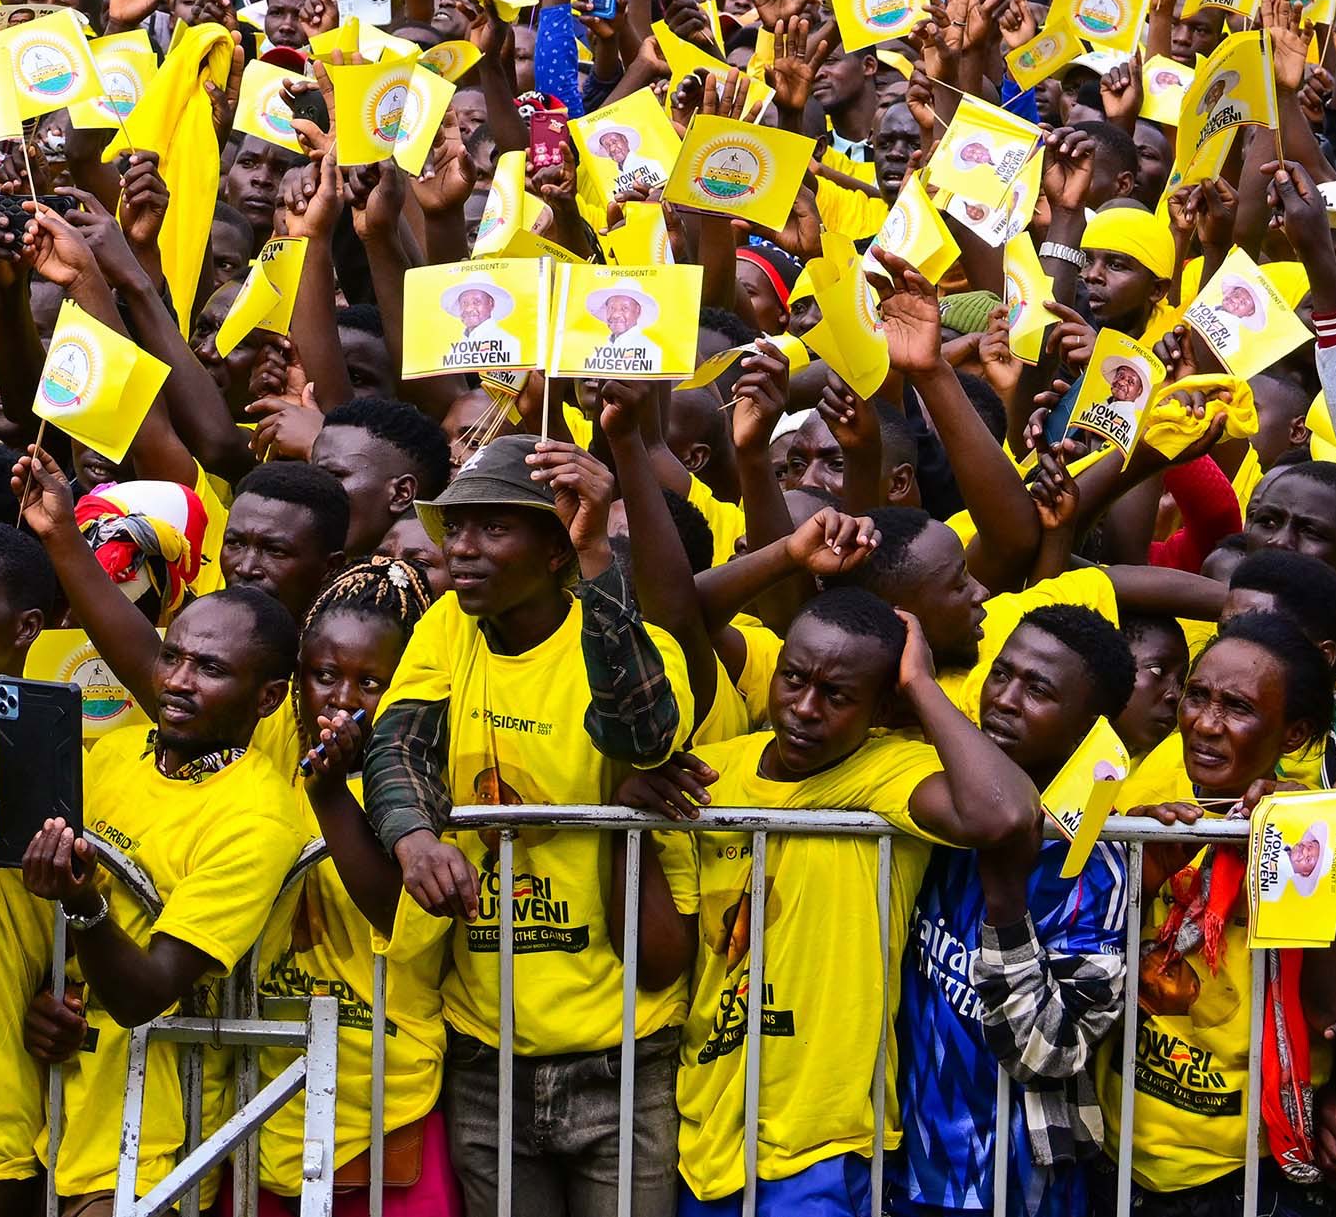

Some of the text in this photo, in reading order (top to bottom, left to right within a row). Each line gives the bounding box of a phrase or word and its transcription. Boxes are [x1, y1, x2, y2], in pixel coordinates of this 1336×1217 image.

[461, 263, 500, 273] PRESIDENT
[611, 269, 649, 278] PRESIDENT
[451, 340, 503, 354] YOWERI
[594, 346, 646, 360] YOWERI
[443, 351, 511, 365] MUSEVENI
[584, 357, 652, 371] MUSEVENI
[1091, 401, 1131, 434] YOWERI
[1079, 410, 1130, 447] MUSEVENI
[1260, 823, 1275, 892] MUSEVENI
[541, 929, 572, 942] GAINS
